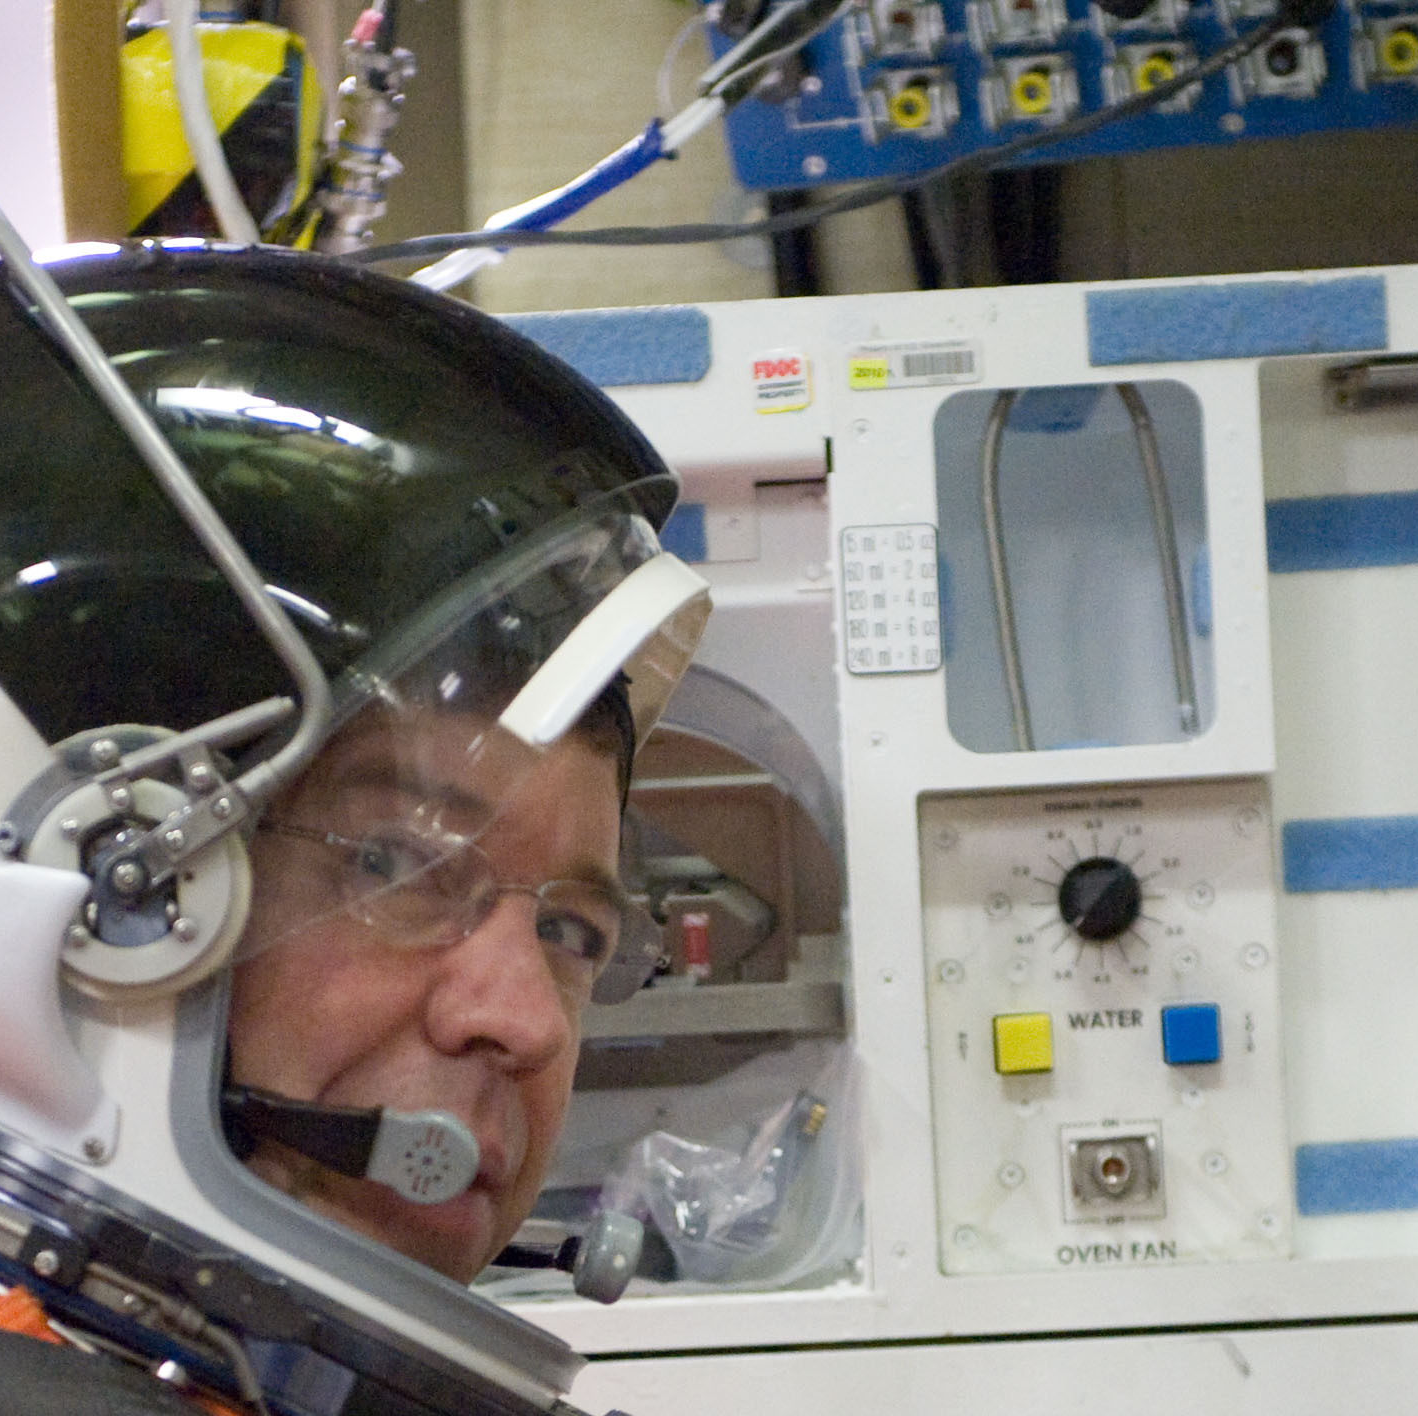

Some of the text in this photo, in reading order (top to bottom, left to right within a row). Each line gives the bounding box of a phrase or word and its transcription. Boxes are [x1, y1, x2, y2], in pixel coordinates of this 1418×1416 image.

[904, 559, 913, 580] 2
[905, 588, 916, 608] 4
[908, 616, 918, 637] 6
[1068, 1009, 1144, 1029] WATER
[1057, 1240, 1177, 1265] OVEN FAN
